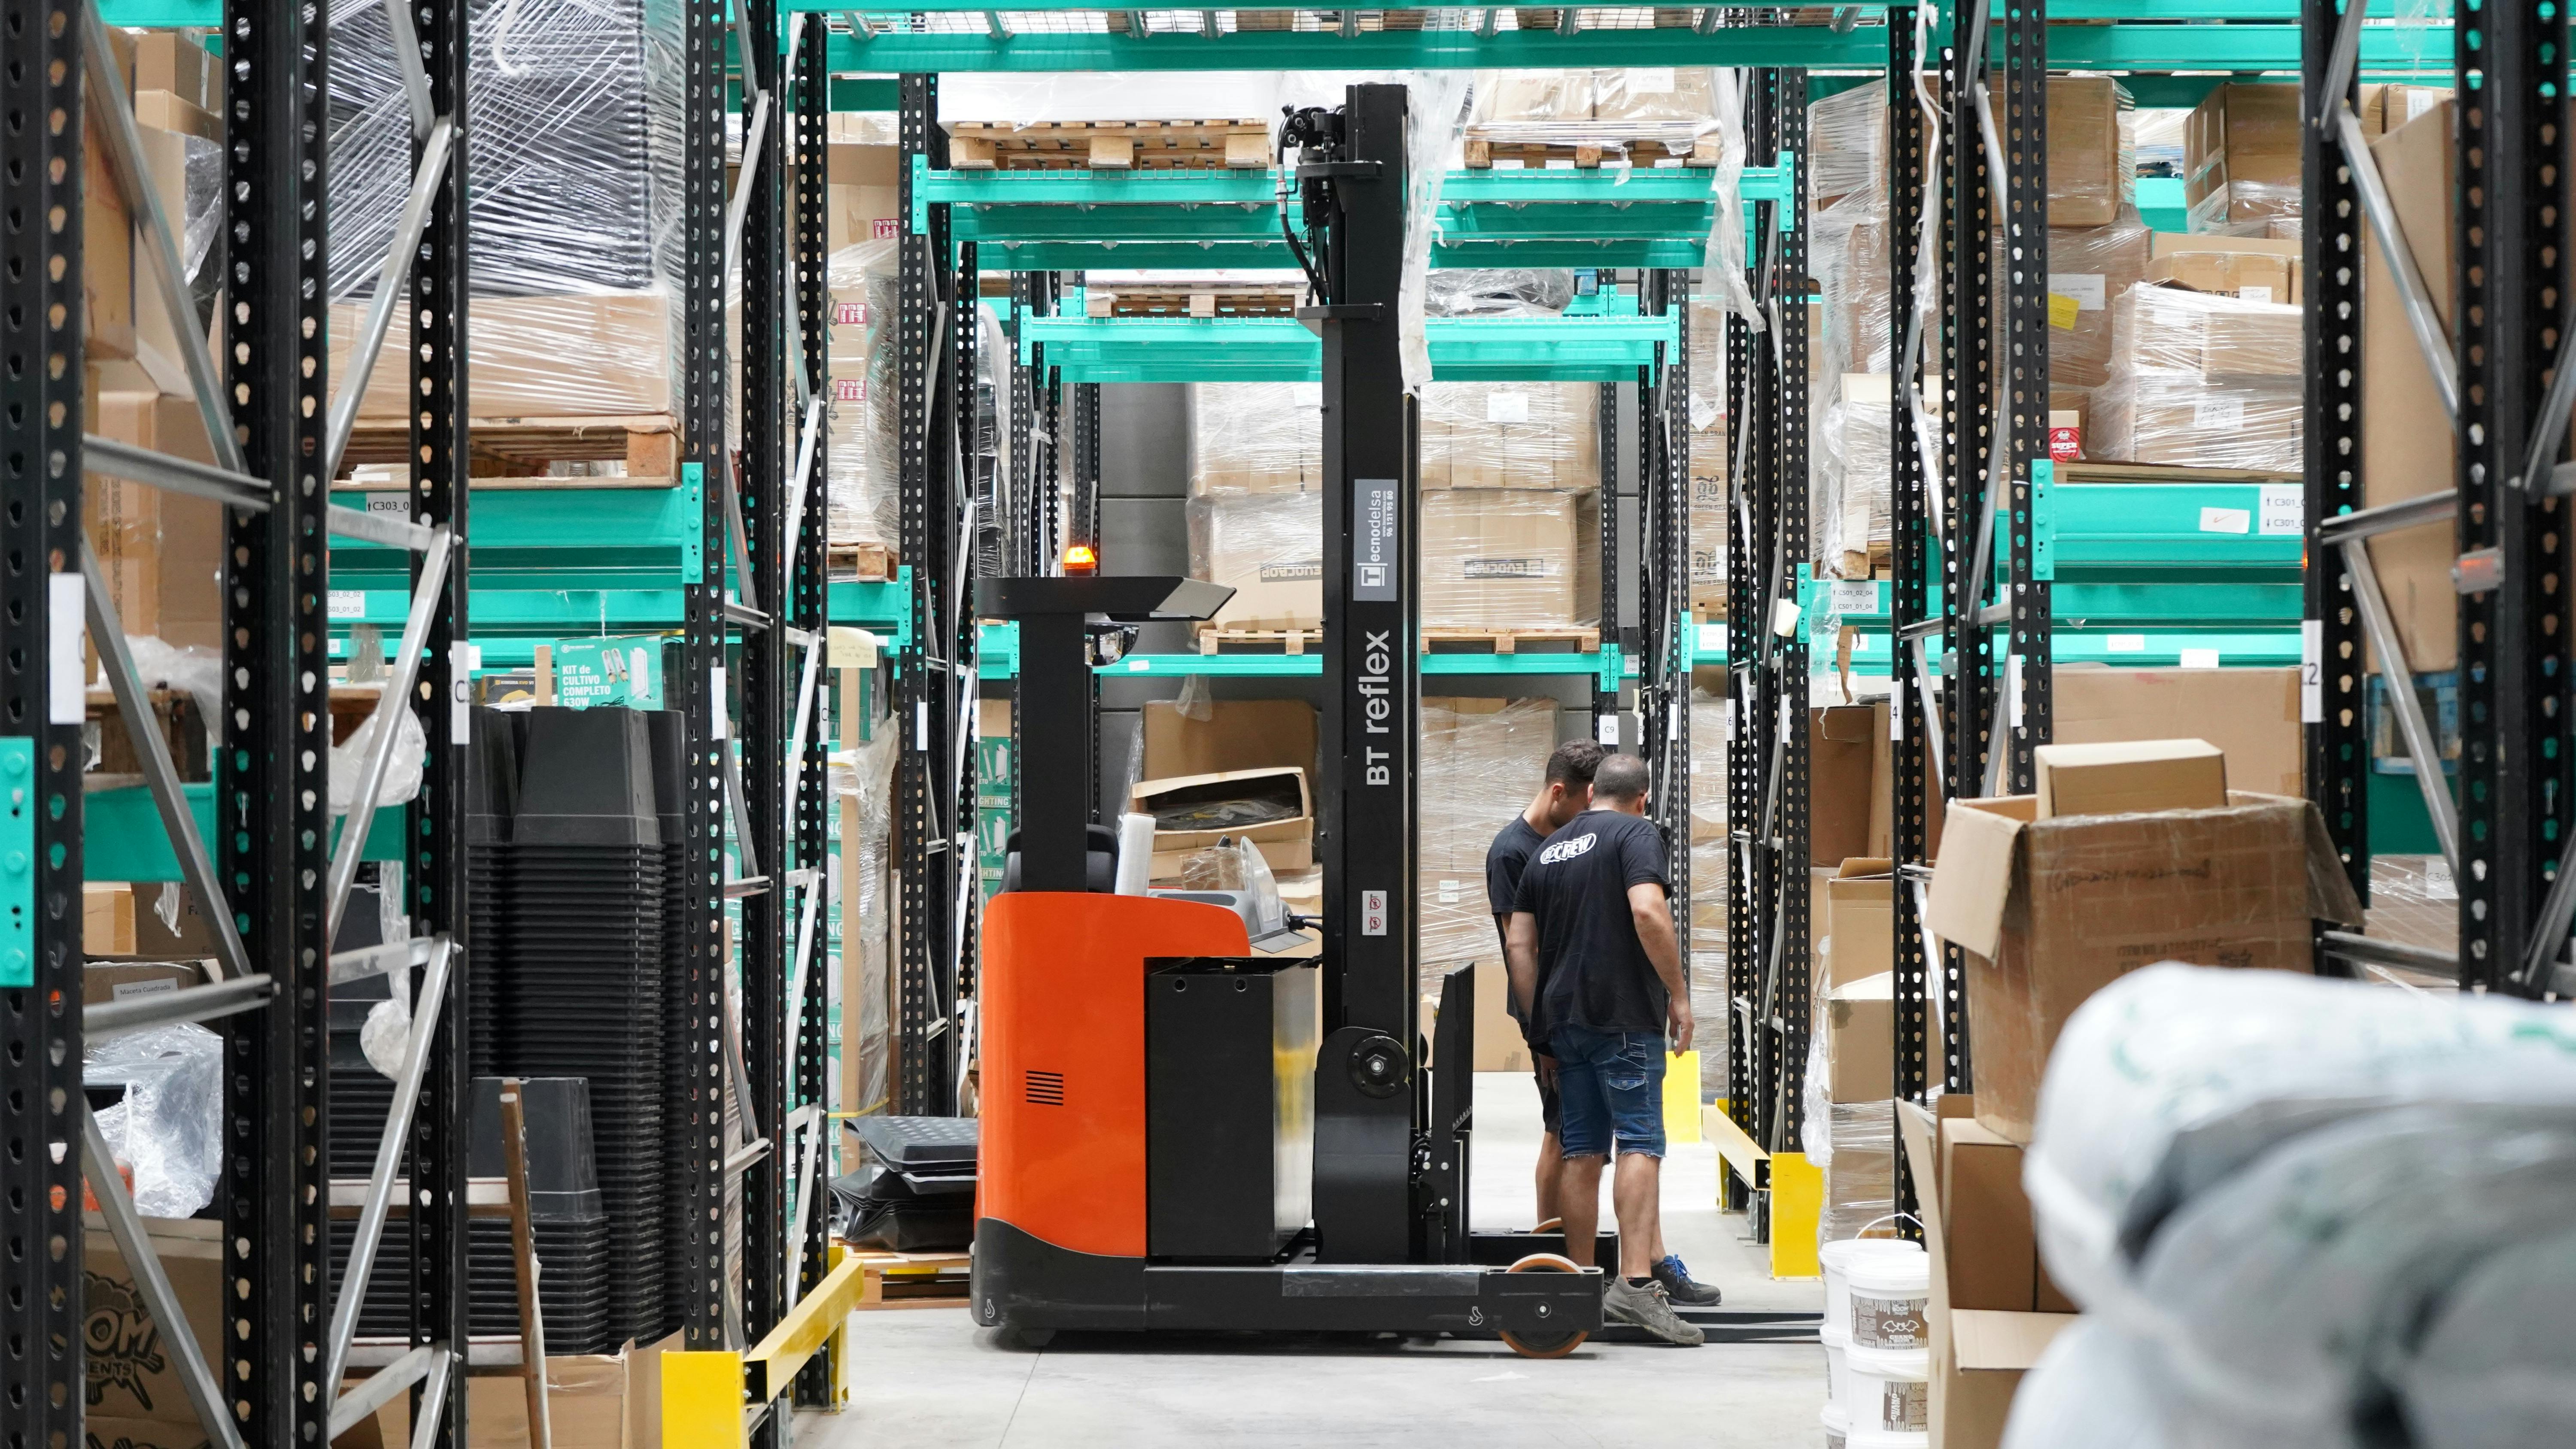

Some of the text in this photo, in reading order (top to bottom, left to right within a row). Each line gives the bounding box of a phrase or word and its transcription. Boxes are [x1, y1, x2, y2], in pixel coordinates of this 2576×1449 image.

[1387, 490, 1394, 500] 80
[1387, 501, 1393, 511] 95
[1387, 528, 1393, 537] 96
[562, 665, 591, 674] KIT de
[563, 675, 600, 685] CULTIVO
[563, 685, 611, 696] COMPLETO
[564, 697, 590, 707] 630W
[1358, 630, 1390, 785] BT reflex
[143, 985, 170, 993] Cuadrada
